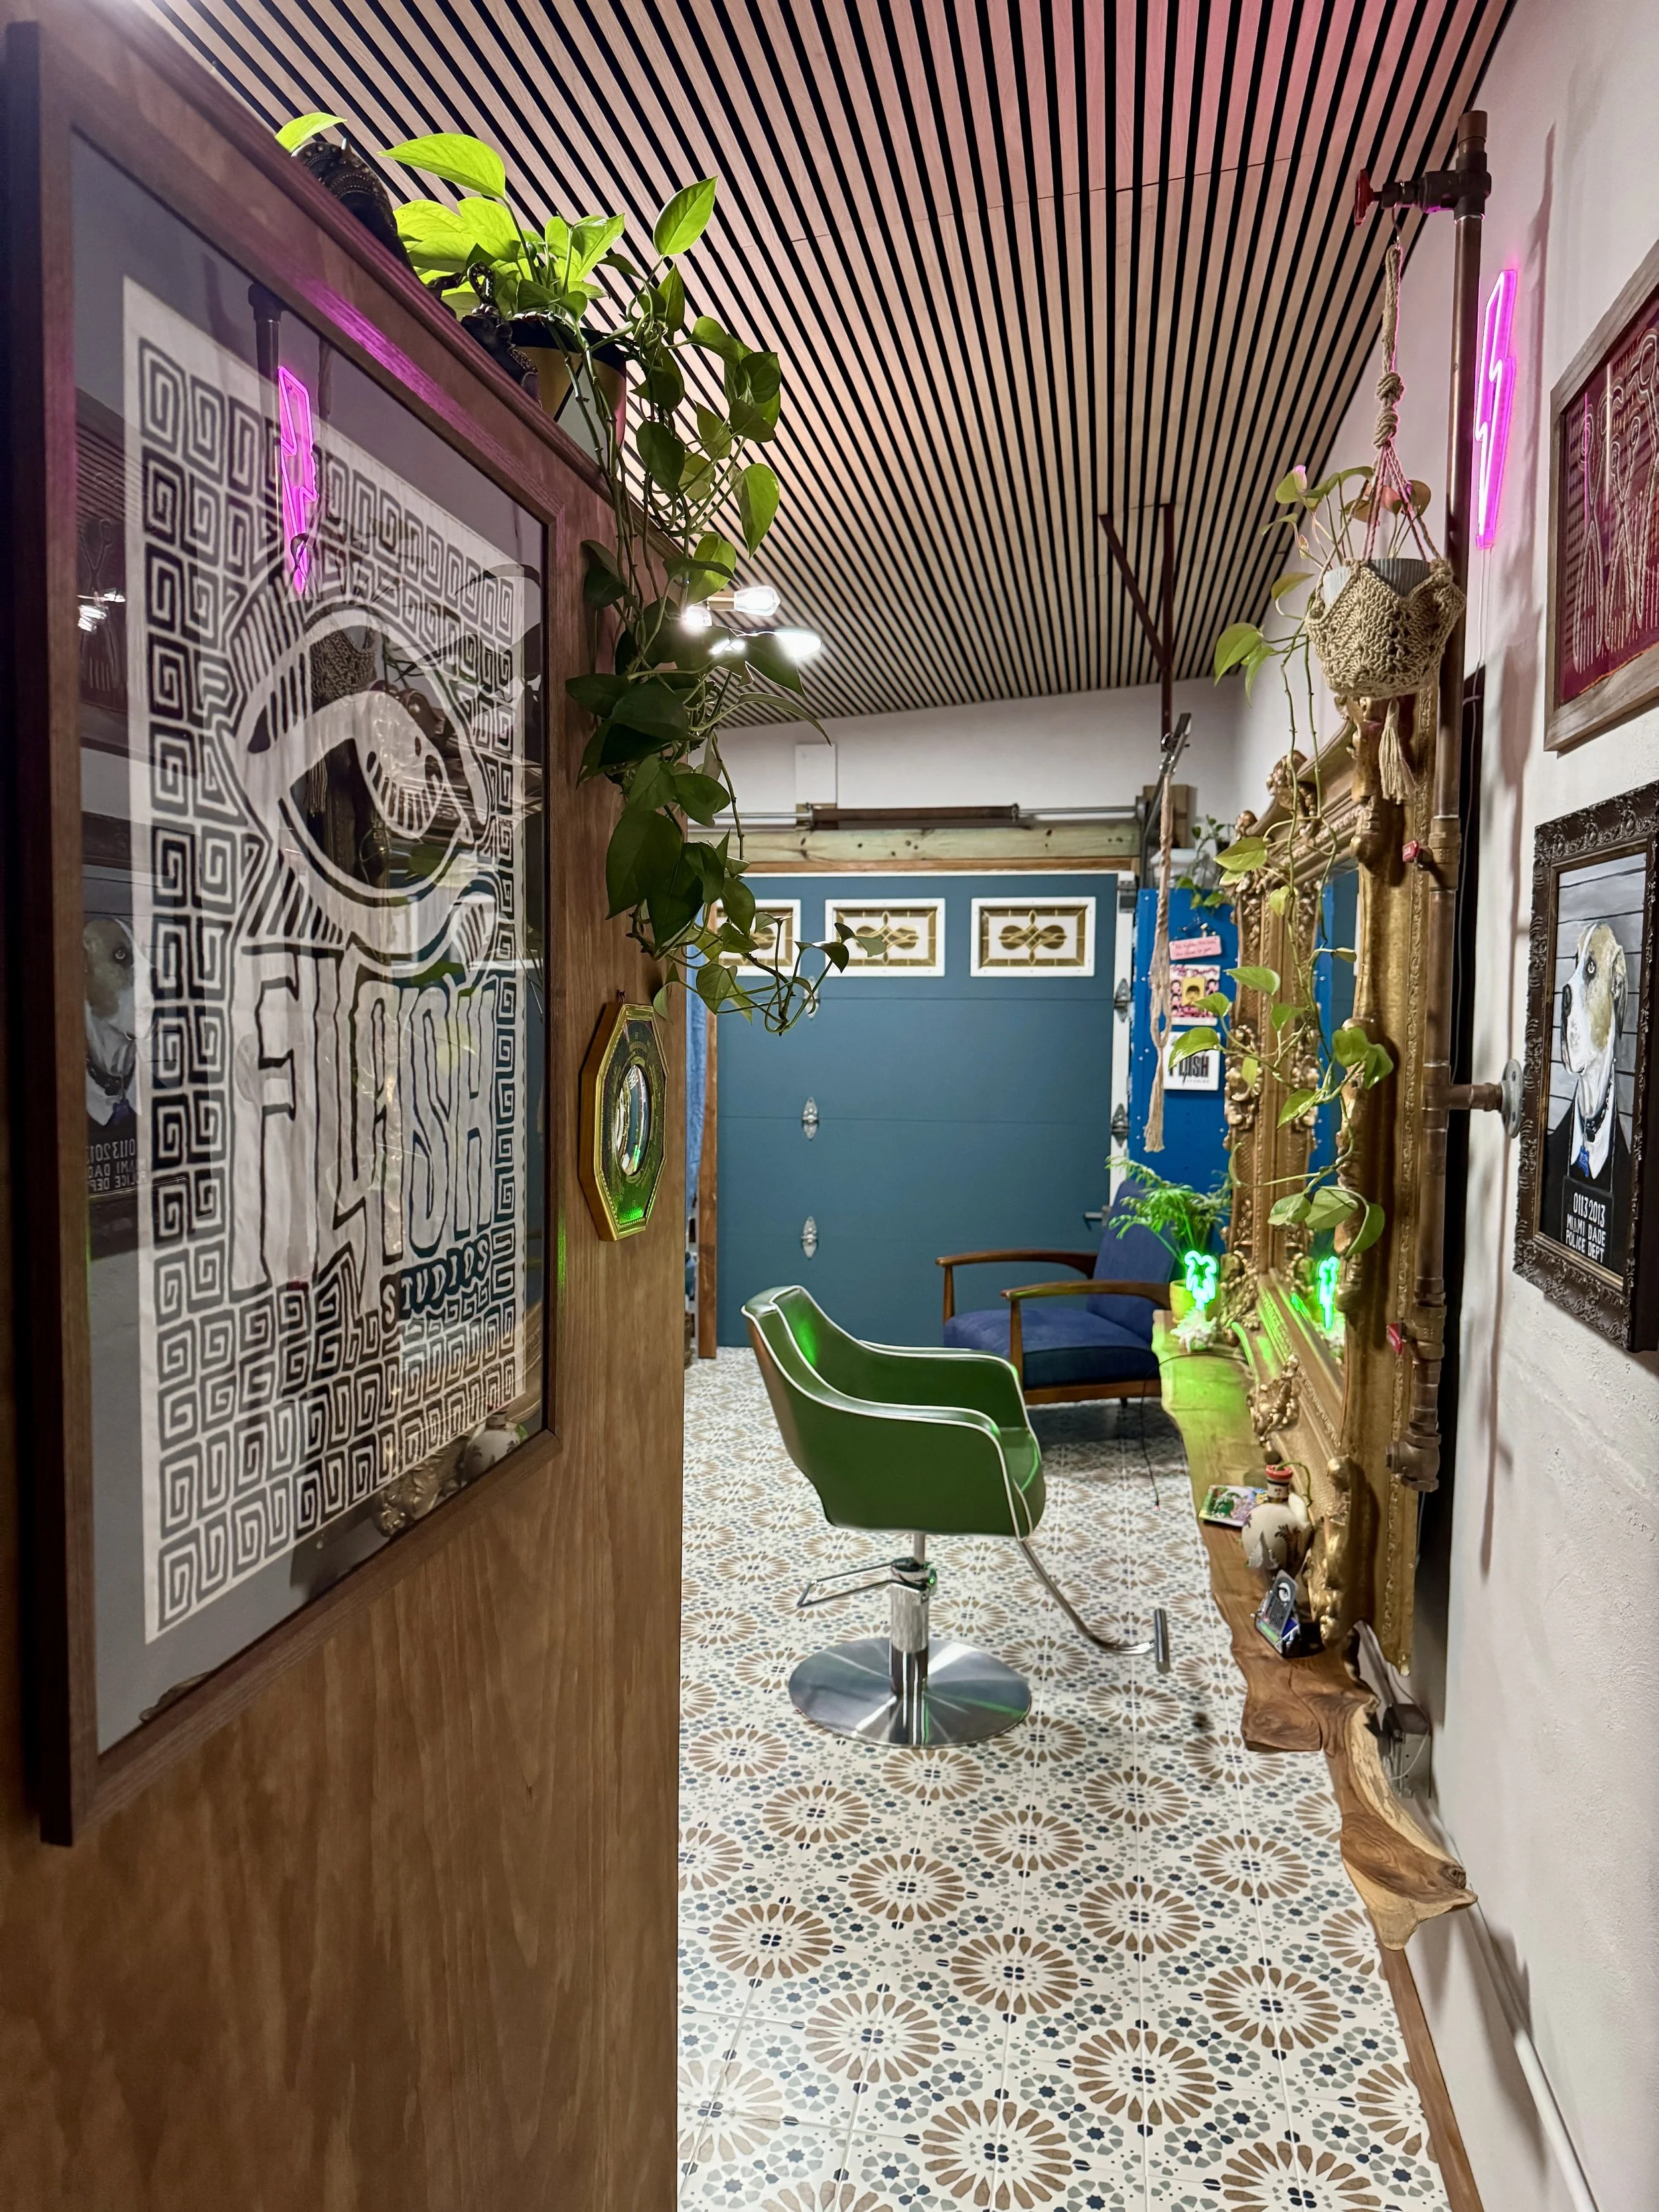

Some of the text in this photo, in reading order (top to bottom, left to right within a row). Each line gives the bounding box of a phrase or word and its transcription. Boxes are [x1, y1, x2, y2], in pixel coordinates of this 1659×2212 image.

[230, 945, 496, 1315] FLASH
[1565, 1229, 1605, 1264] POLICE DEPT
[1566, 1213, 1607, 1247] MIAMI DADE
[382, 1238, 488, 1325] STUDIOS
